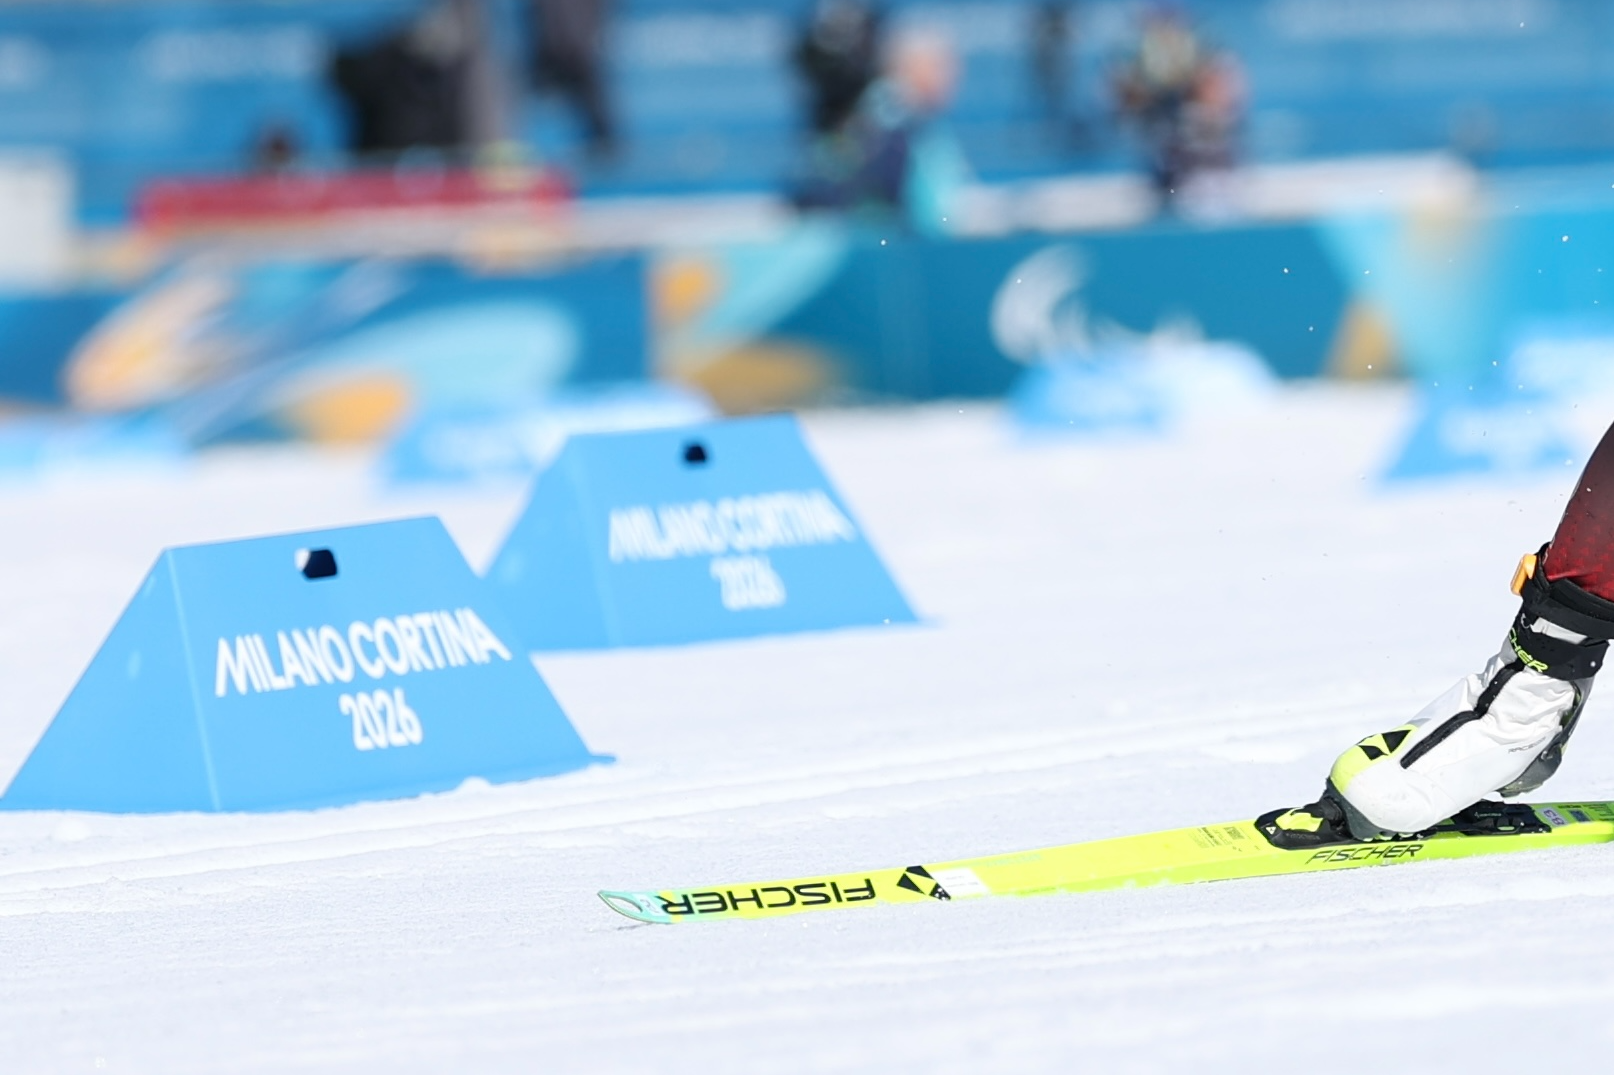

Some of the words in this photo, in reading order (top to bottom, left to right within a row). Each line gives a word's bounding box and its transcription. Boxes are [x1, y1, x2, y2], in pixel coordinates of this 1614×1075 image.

[214, 624, 355, 698] MILANO
[347, 606, 513, 680] CORTINA
[338, 685, 424, 752] 2026
[1304, 843, 1424, 865] FISCHER
[655, 877, 877, 916] FISCHER
